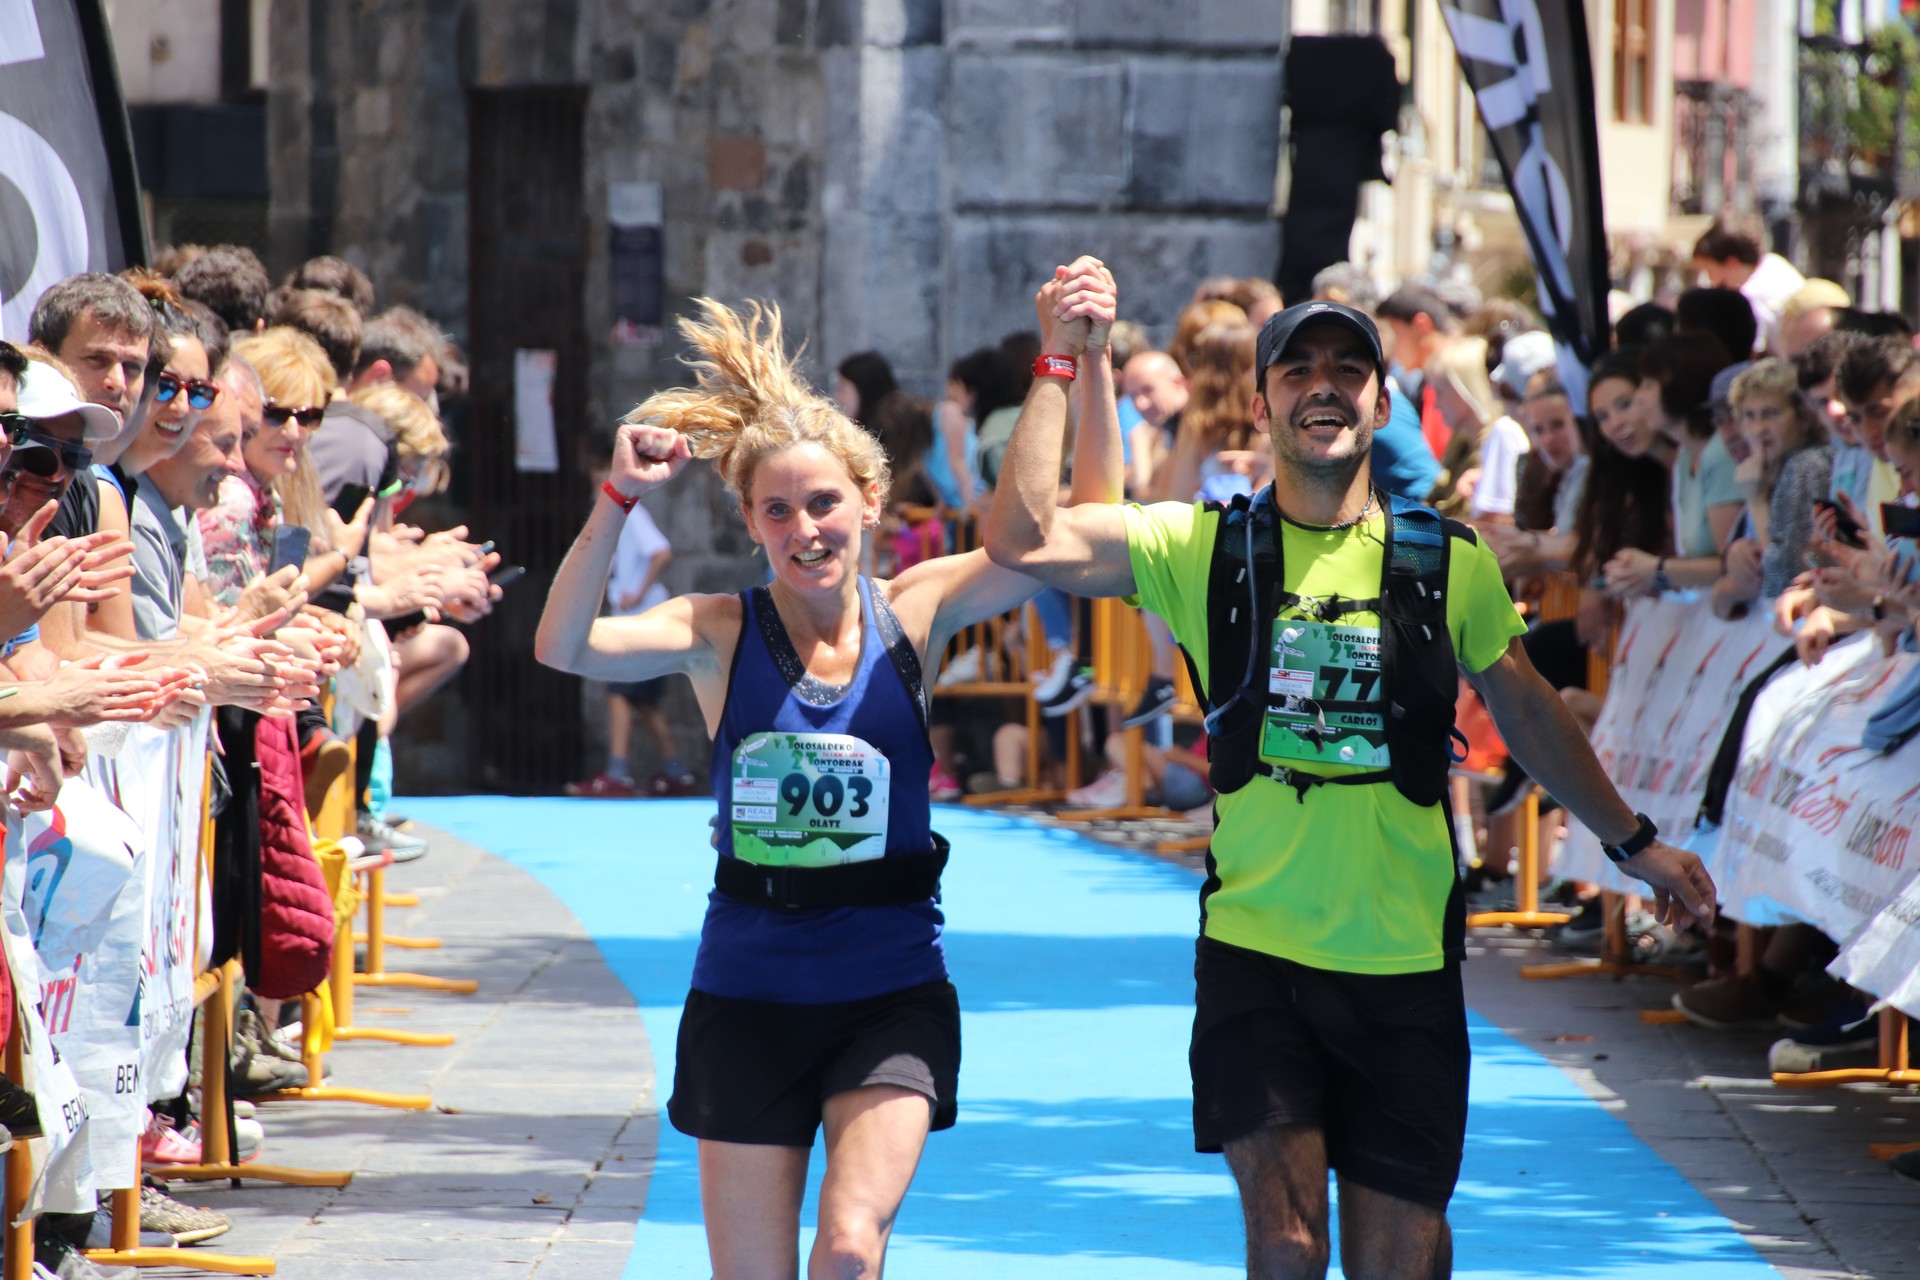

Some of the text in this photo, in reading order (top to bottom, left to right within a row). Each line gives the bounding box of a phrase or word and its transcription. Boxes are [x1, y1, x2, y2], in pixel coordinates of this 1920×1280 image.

[1329, 641, 1342, 663] 2
[1340, 715, 1378, 726] CARLOS
[786, 735, 853, 750] TOLOSALDEKO
[791, 750, 864, 770] 2 TONTORRAK
[781, 772, 873, 818] 903
